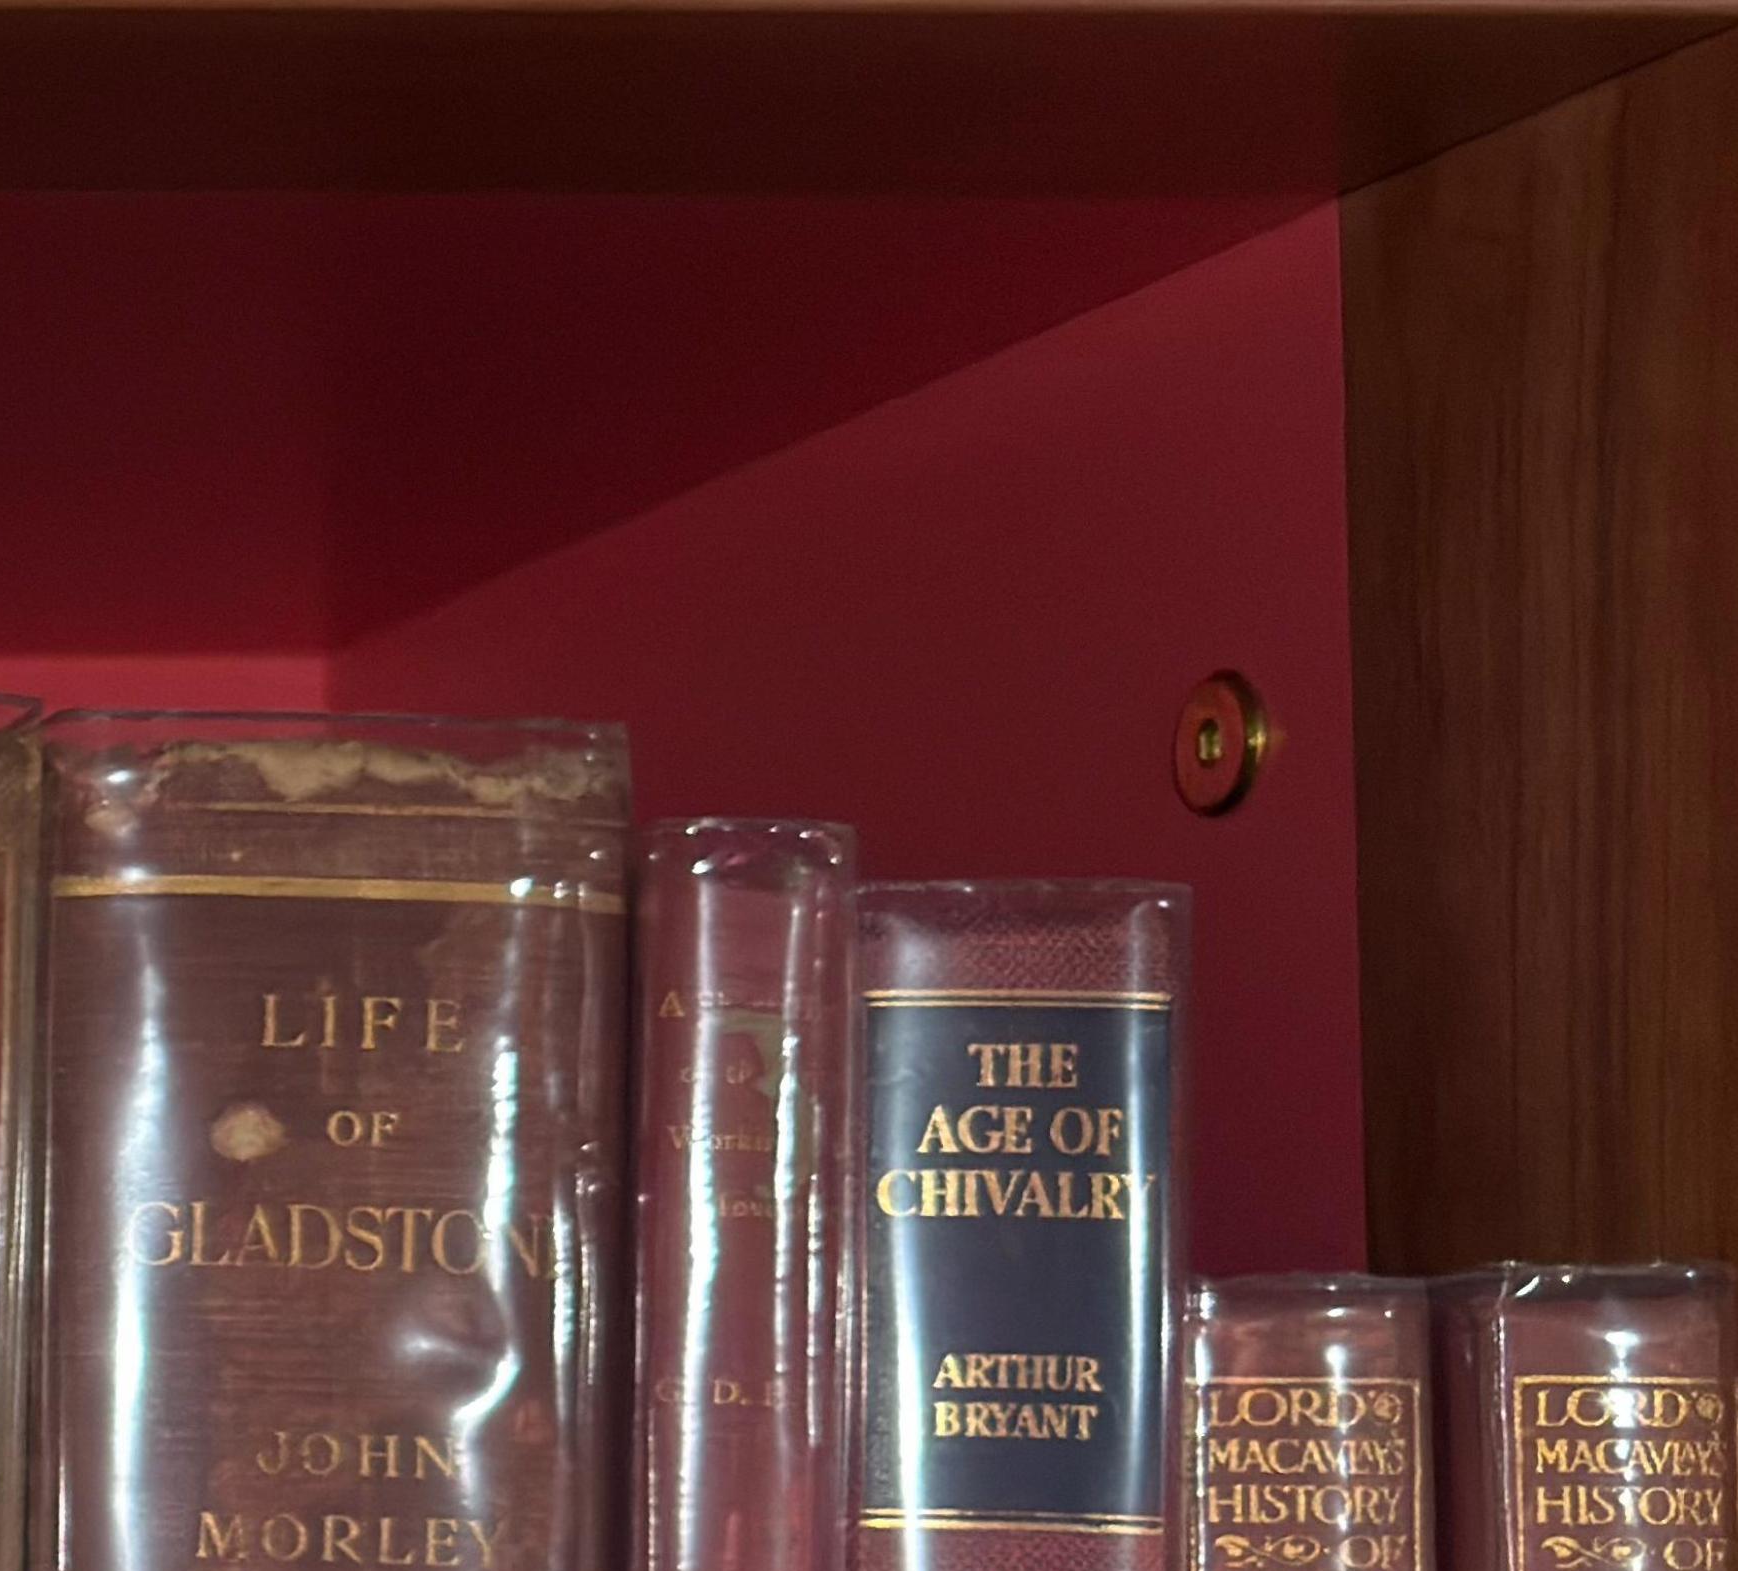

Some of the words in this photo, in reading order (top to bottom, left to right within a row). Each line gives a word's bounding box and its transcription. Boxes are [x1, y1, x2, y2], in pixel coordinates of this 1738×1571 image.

[261, 993, 466, 1053] LIFE
[968, 1043, 1078, 1088] THE
[327, 1110, 401, 1148] OF
[916, 1104, 1035, 1155] AGE
[1050, 1107, 1123, 1157] OF
[876, 1169, 1156, 1221] CHIVALRY
[128, 1201, 570, 1278] GLADSTON
[932, 1353, 1104, 1393] ARTHUR
[934, 1401, 1098, 1440] BRYANT
[1208, 1387, 1367, 1428] LORD
[256, 1430, 460, 1480] JOHN
[1208, 1484, 1403, 1525] HISTORY
[1537, 1485, 1723, 1526] HISTORY
[195, 1511, 506, 1569] MORLEY
[1339, 1534, 1407, 1570] OF
[1663, 1536, 1729, 1571] OF
